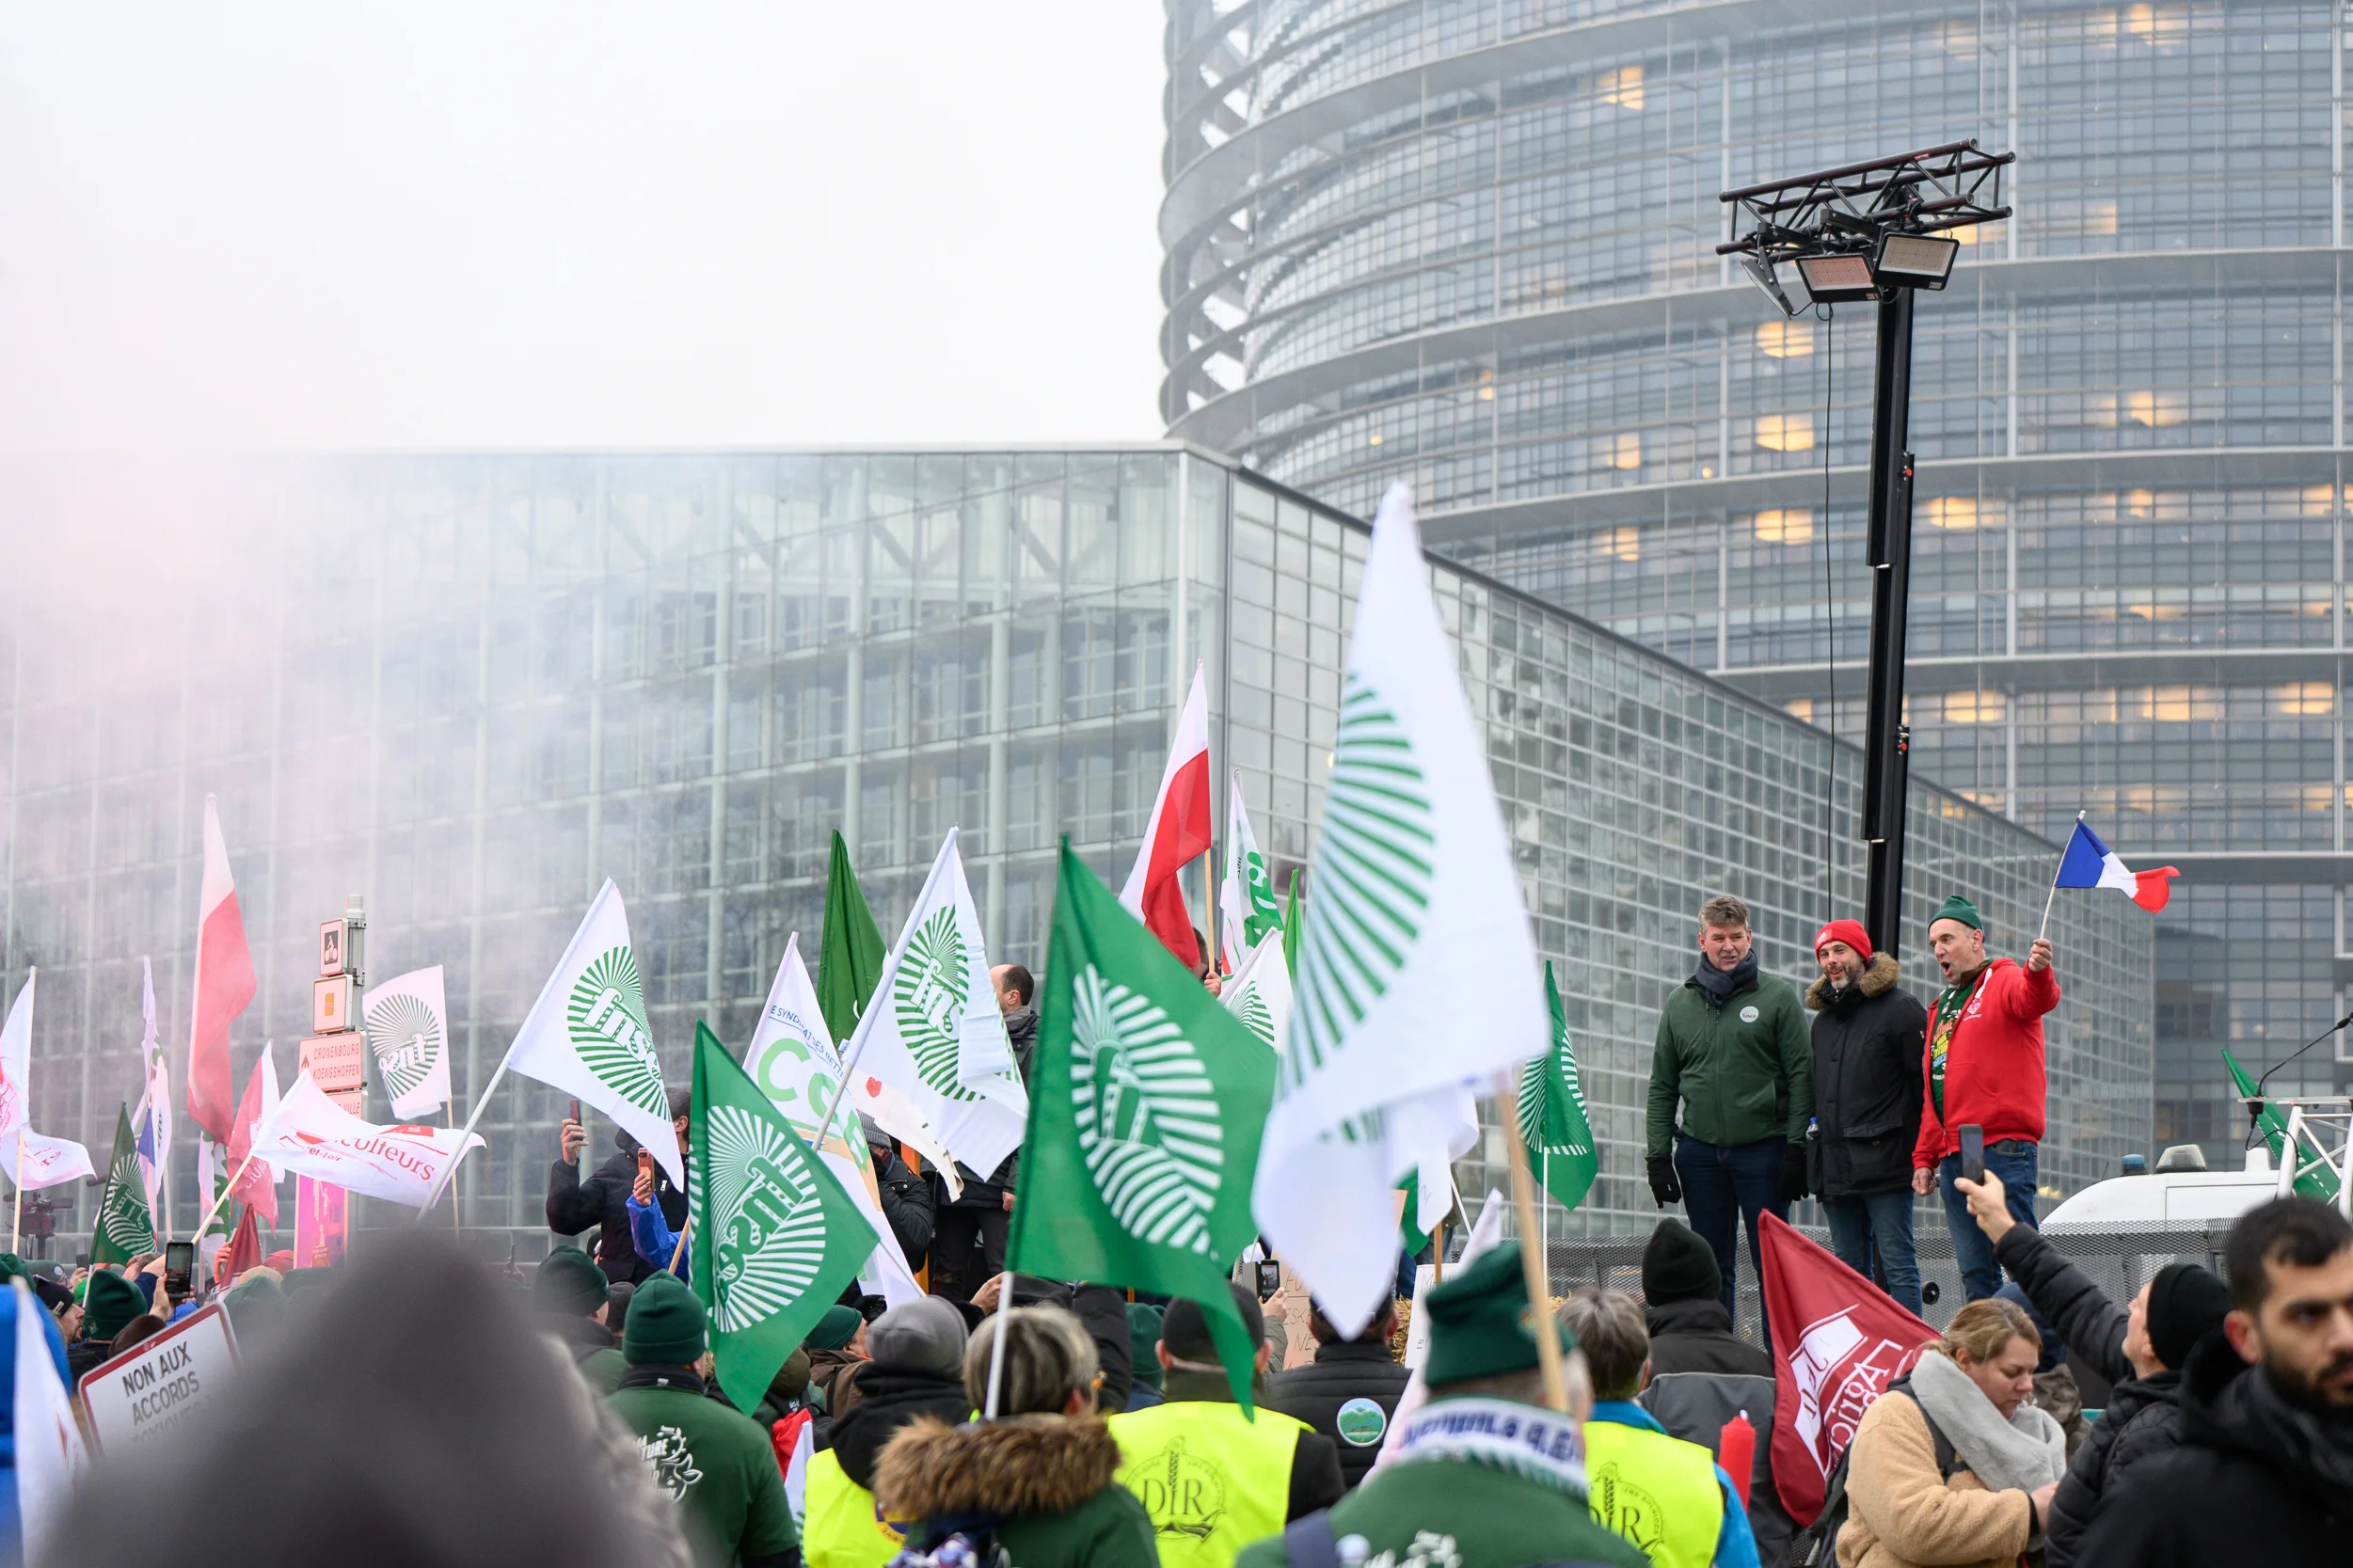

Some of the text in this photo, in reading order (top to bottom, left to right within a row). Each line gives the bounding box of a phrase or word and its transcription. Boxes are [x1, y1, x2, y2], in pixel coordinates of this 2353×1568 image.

[313, 1042, 360, 1061] CRONENBOURG
[122, 1340, 193, 1398] NON AUX
[132, 1370, 200, 1427] ACCORDS
